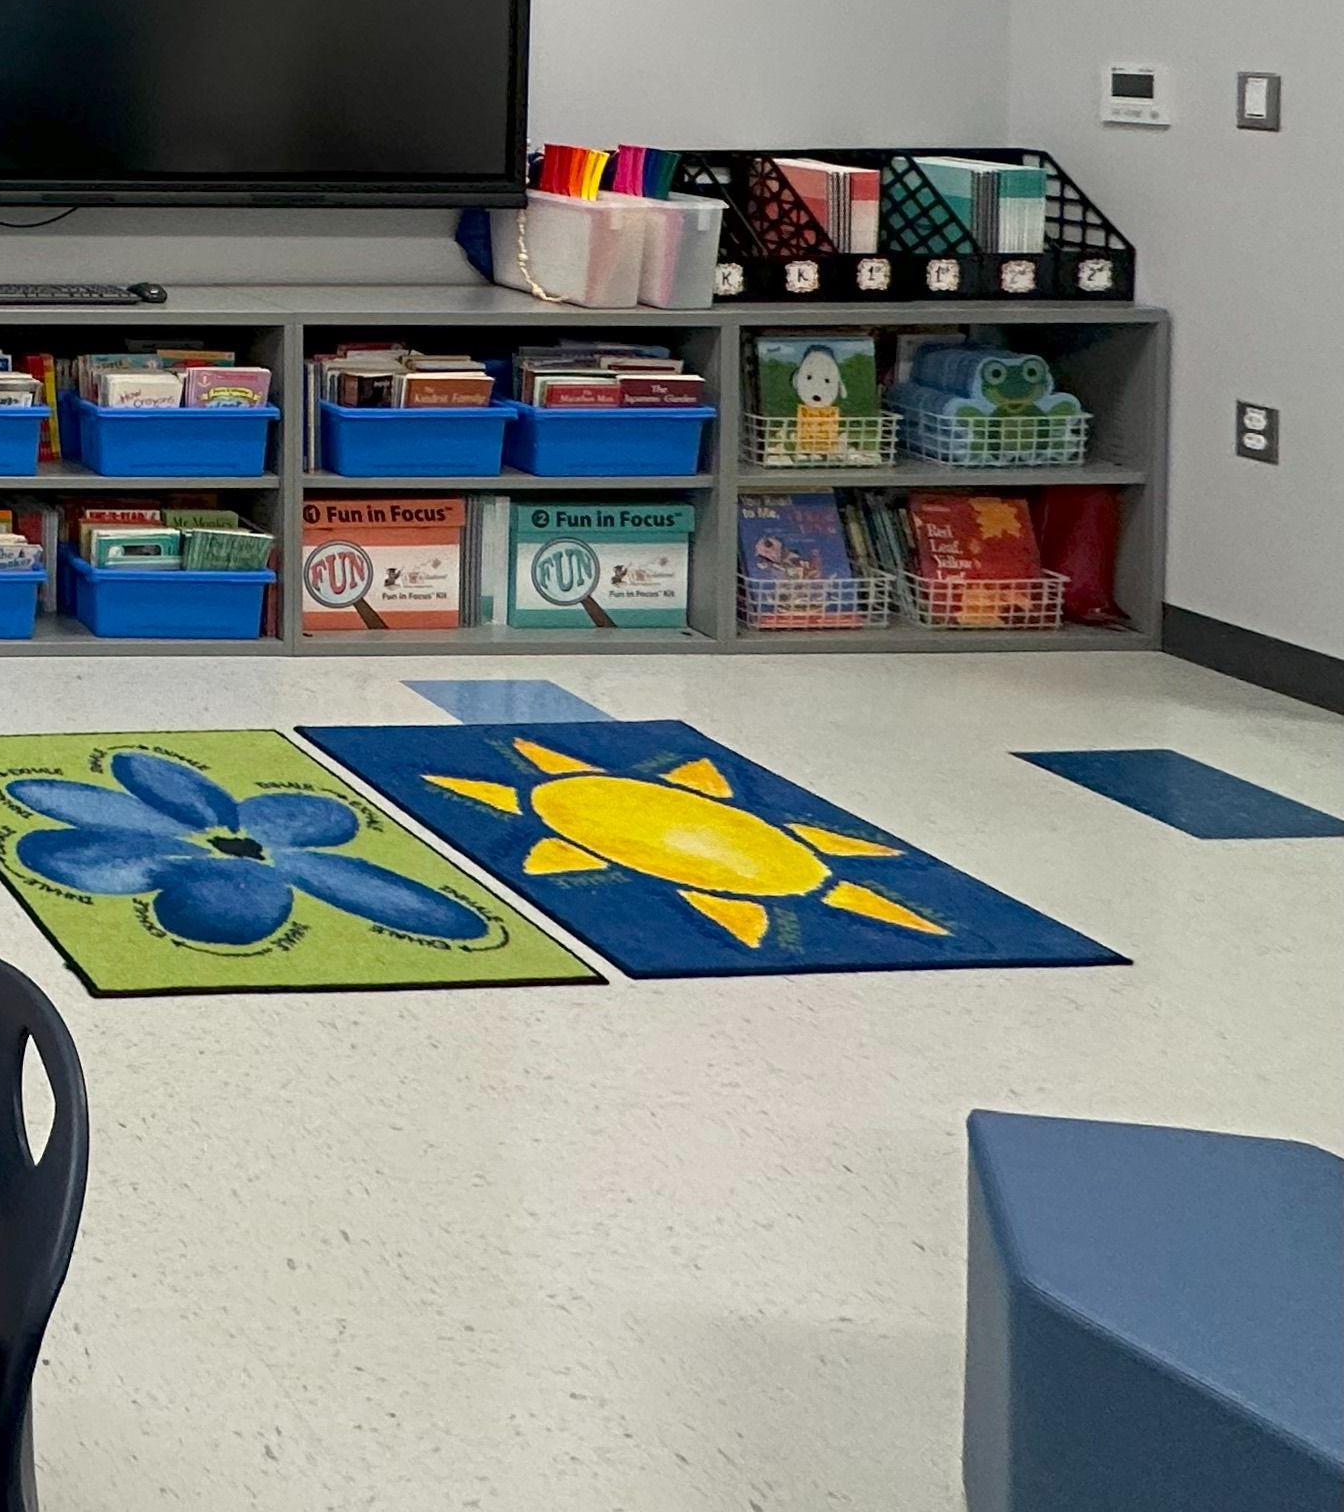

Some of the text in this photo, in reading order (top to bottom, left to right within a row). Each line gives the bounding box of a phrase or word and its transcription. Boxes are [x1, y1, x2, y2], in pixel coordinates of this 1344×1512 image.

[723, 272, 733, 286] K
[797, 269, 808, 282] K
[650, 384, 668, 393] The
[326, 506, 363, 523] Fun
[366, 505, 386, 523] in
[556, 511, 592, 527] Fun
[597, 510, 615, 527] in
[926, 523, 954, 538] Red
[933, 554, 974, 569] Yellow
[310, 550, 366, 595] FUN
[537, 548, 593, 592] FUN
[382, 592, 398, 600] Fun
